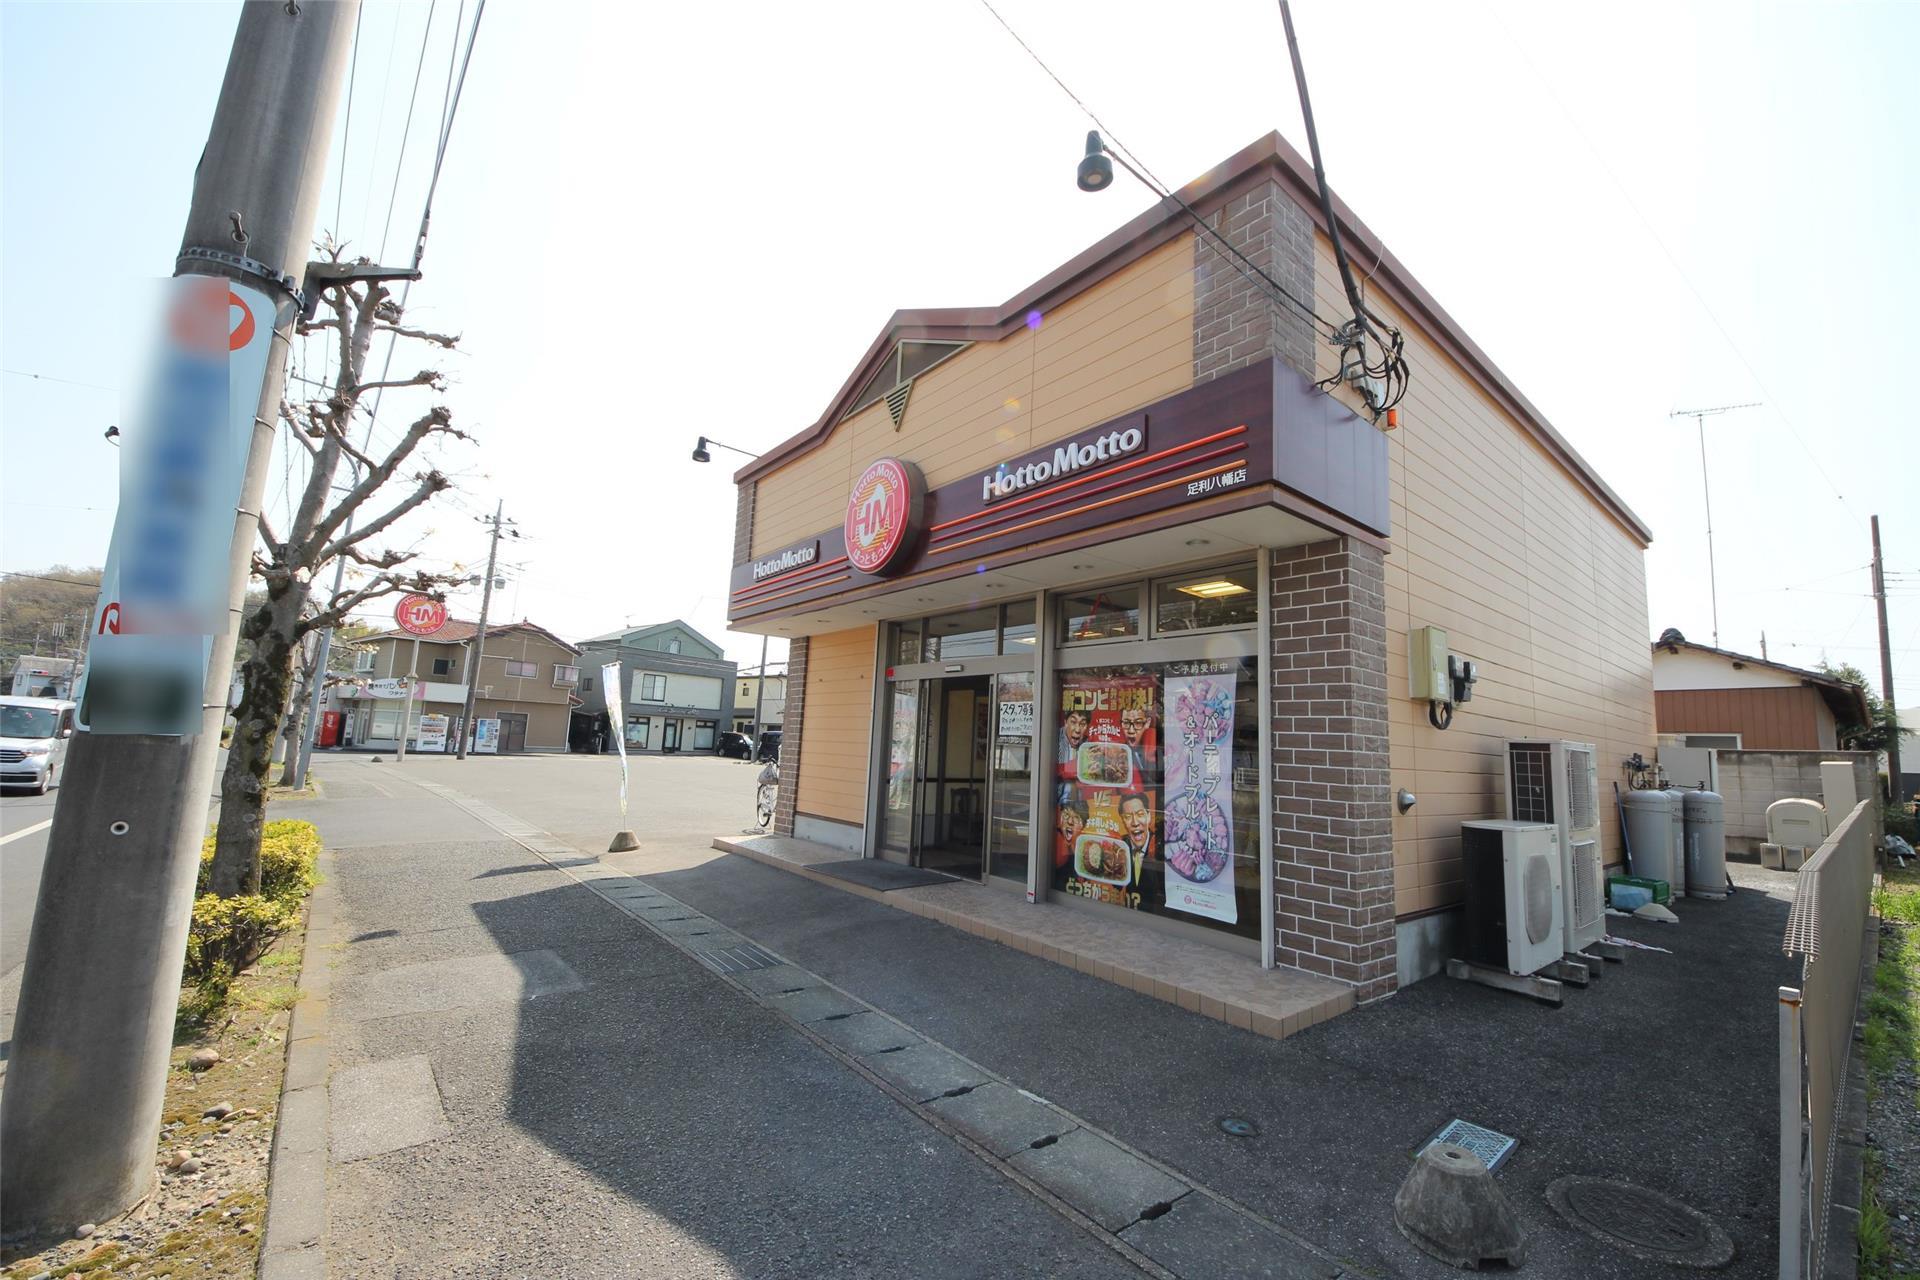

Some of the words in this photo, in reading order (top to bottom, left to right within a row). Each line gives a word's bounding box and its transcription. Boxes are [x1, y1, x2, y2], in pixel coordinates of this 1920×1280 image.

[982, 428, 1143, 500] HottoMotto
[1187, 468, 1248, 497] 足利八幡店
[851, 492, 895, 543] HM
[753, 547, 816, 580] HottoMotto
[853, 540, 892, 564] ほっともっと
[403, 606, 441, 625] HM
[1172, 662, 1229, 674] ご予約受付中
[1093, 789, 1113, 808] VS
